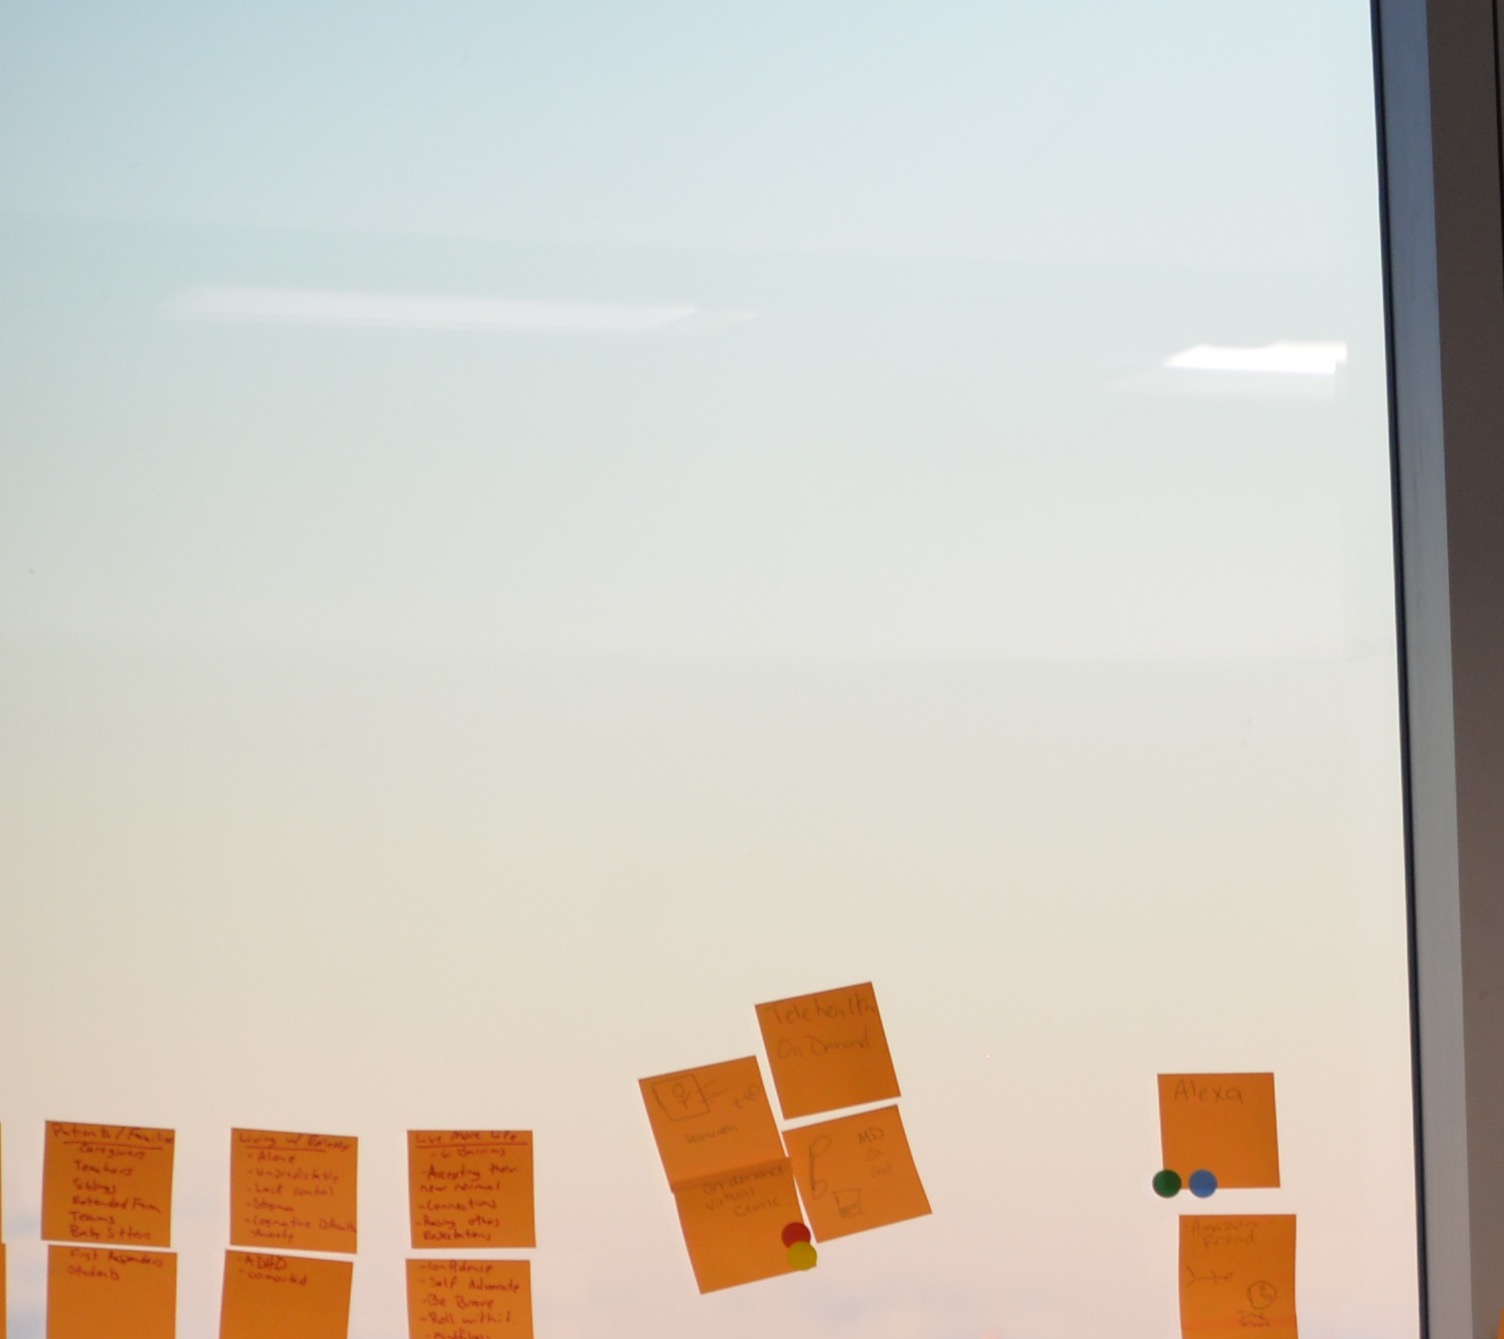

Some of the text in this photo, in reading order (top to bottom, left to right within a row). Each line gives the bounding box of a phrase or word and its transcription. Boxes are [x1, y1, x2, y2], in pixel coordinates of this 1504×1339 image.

[1173, 1079, 1244, 1104] Alexa
[73, 1160, 134, 1177] Teachers
[72, 1177, 117, 1195] Siblings
